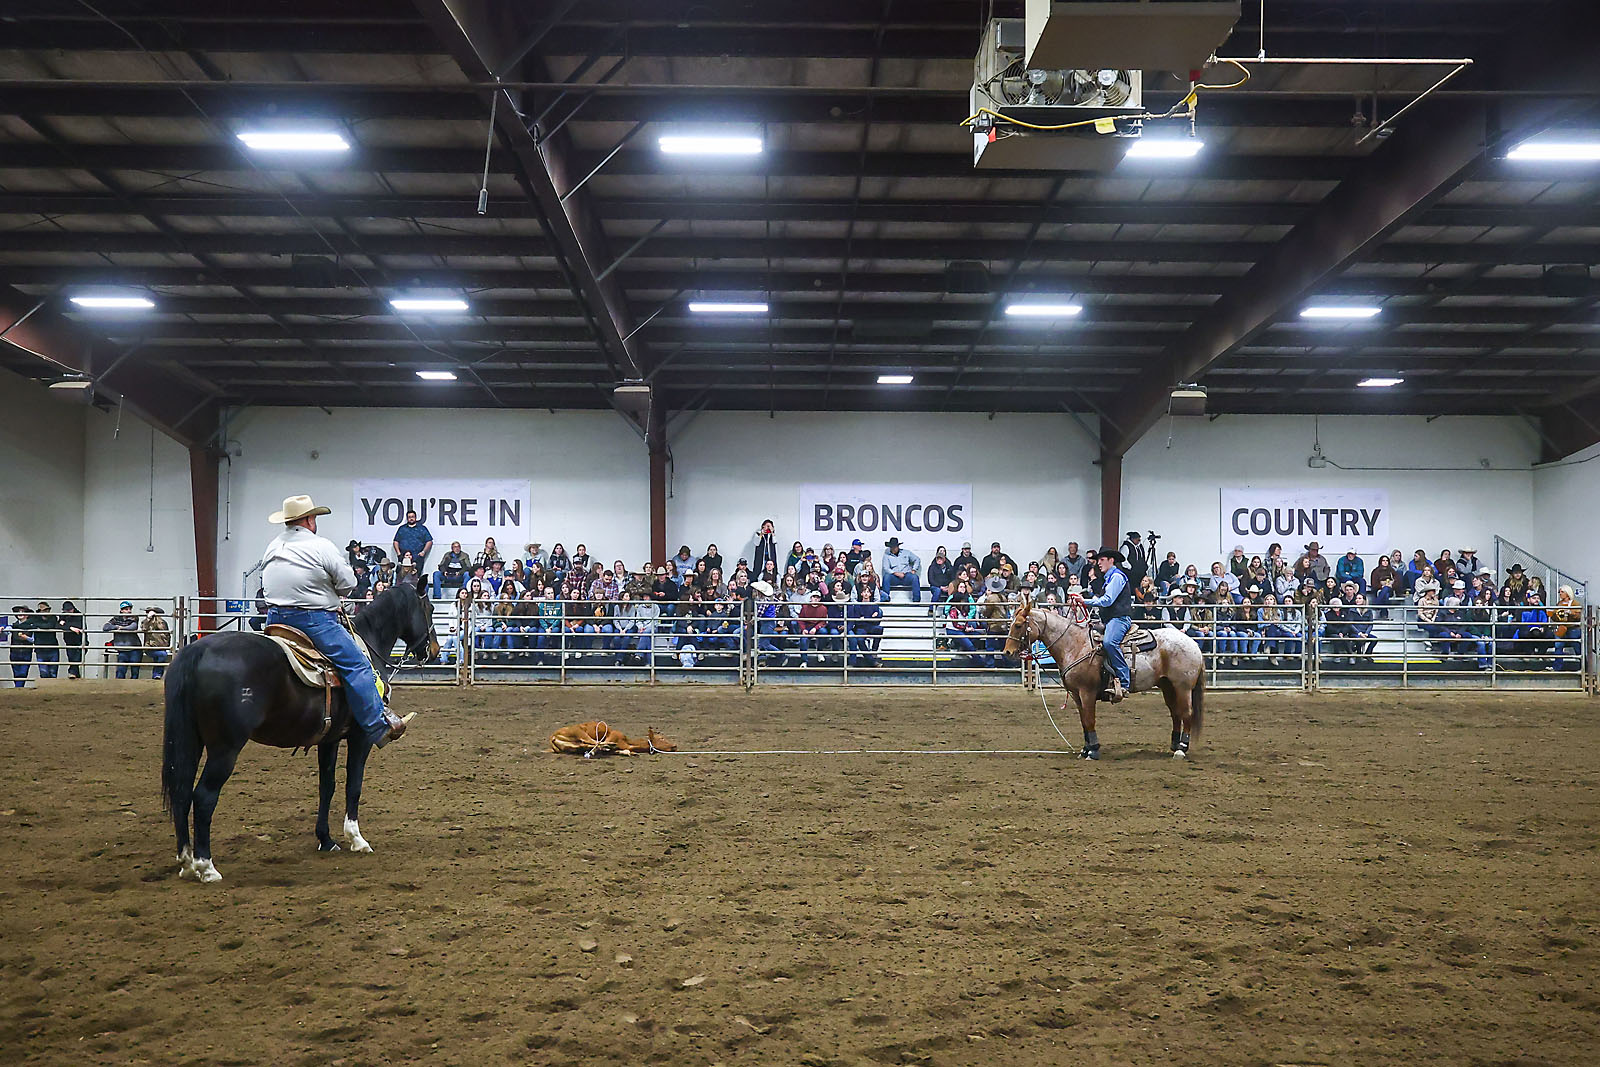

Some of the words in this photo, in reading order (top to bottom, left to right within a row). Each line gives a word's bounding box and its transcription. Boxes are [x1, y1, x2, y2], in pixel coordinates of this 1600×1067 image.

[361, 498, 478, 526] YOU'RE
[489, 499, 520, 526] IN
[814, 504, 963, 532] BRONCOS
[1231, 508, 1381, 537] COUNTRY
